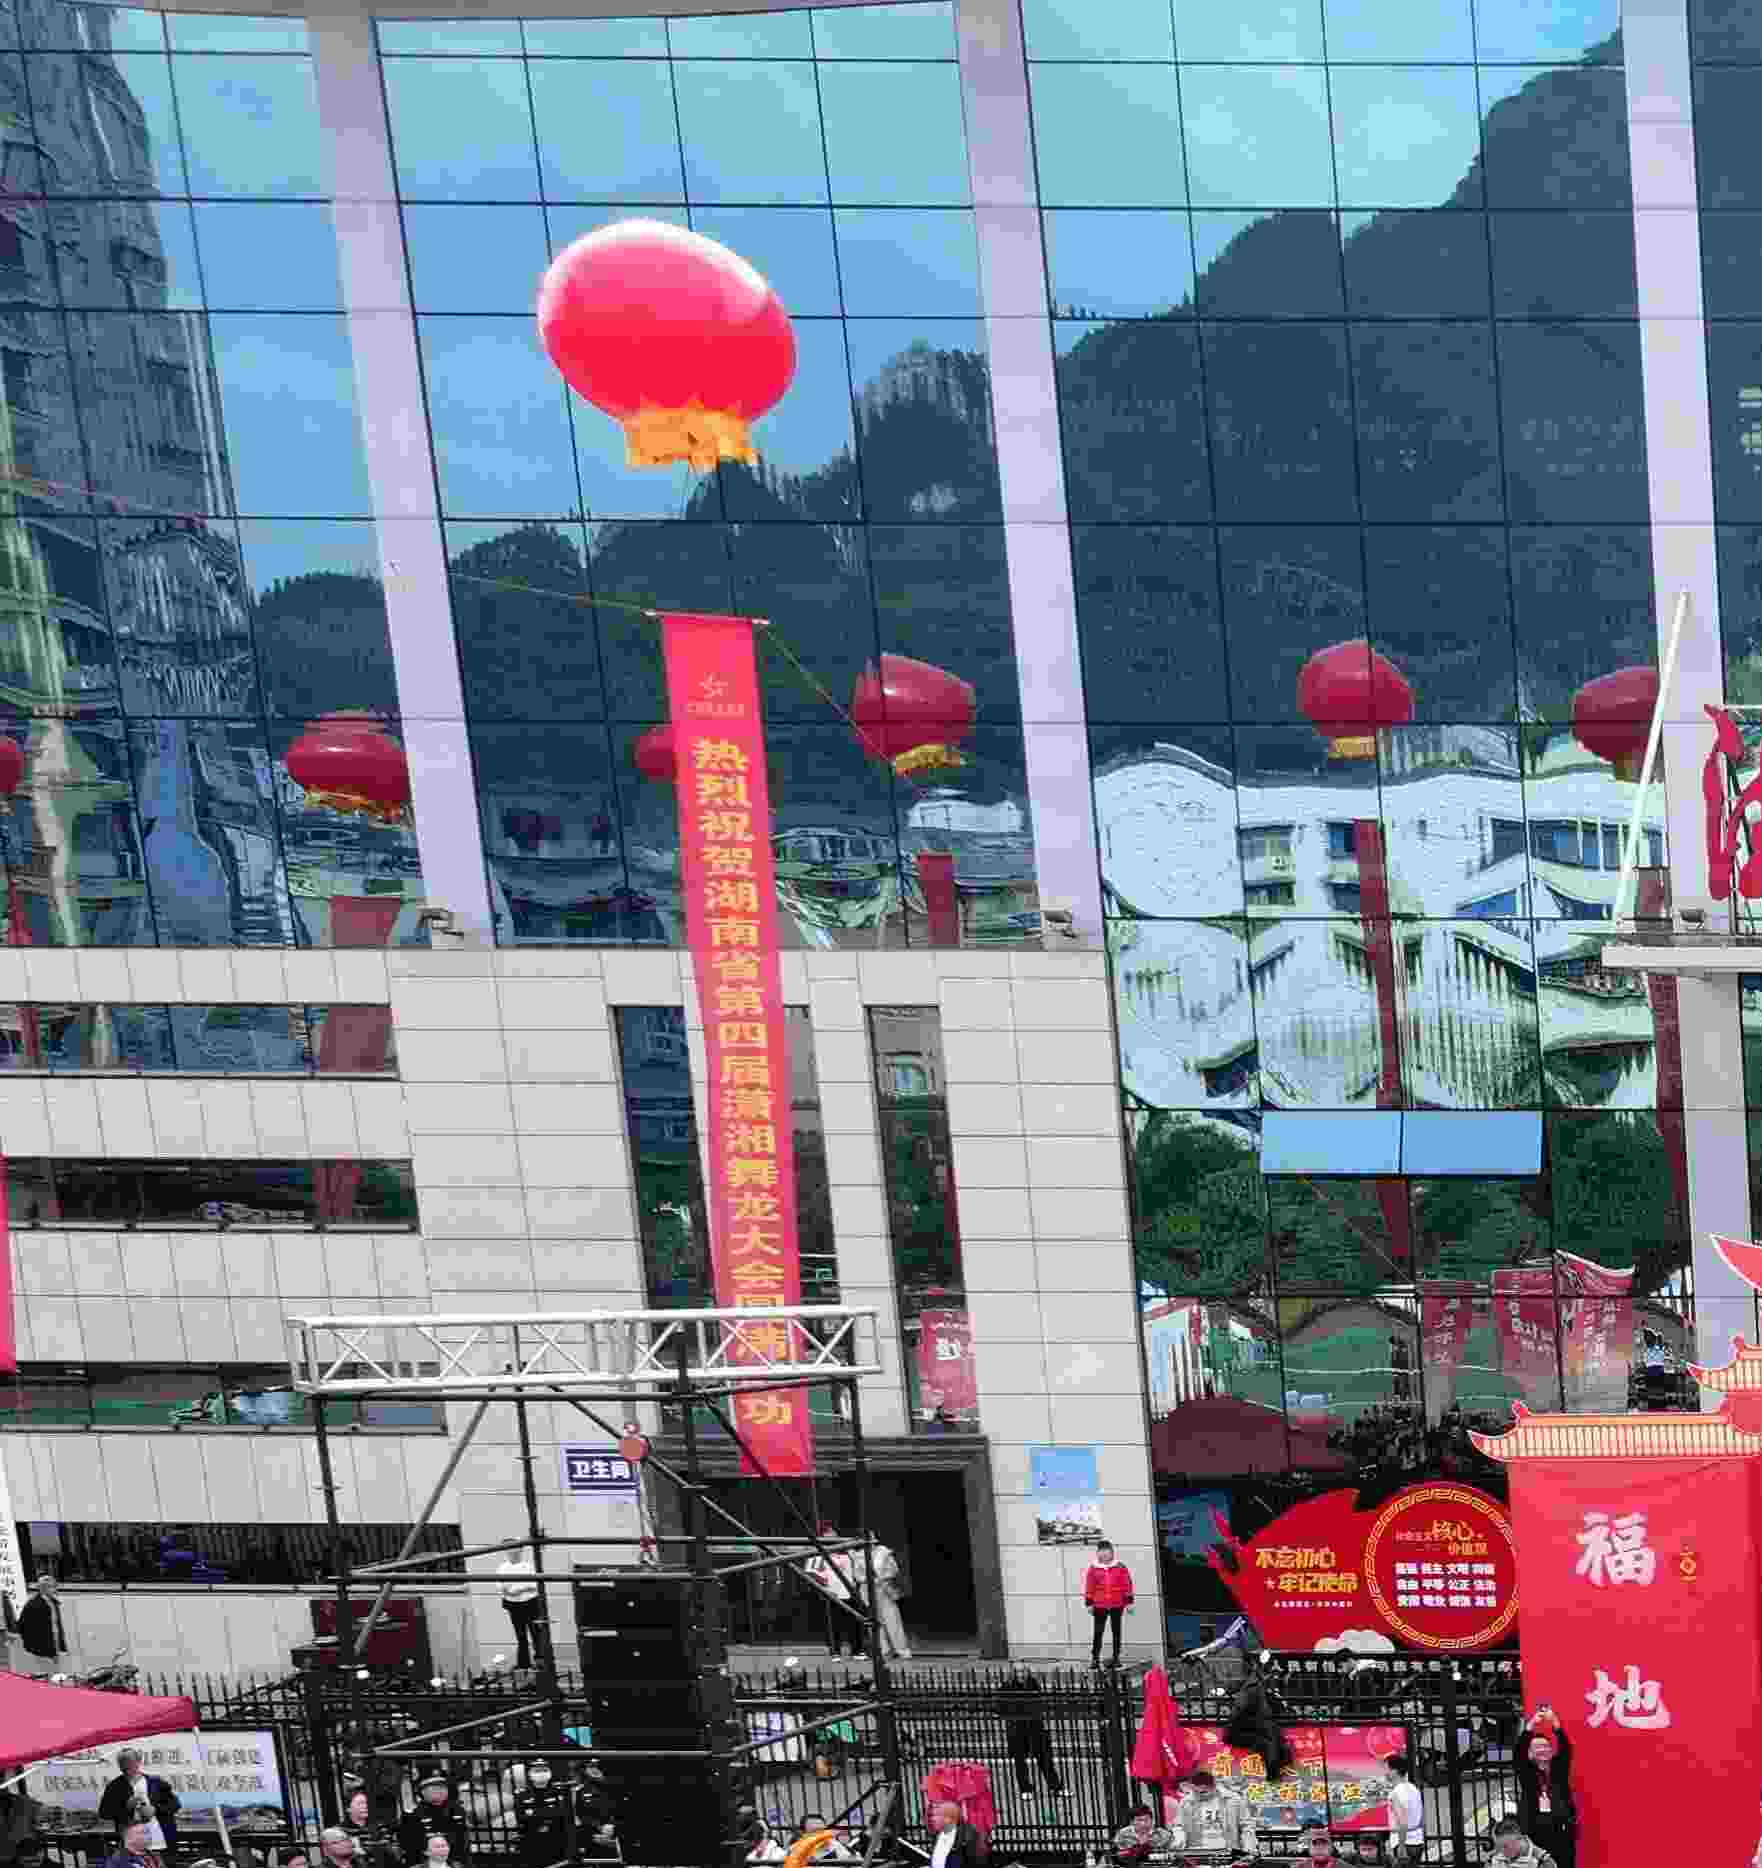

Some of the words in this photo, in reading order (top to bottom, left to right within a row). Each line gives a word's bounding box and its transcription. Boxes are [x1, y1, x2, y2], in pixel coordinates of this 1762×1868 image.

[572, 1460, 630, 1478] 卫生间
[1256, 1546, 1337, 1569] 不忘初心
[1575, 1510, 1673, 1731] 福地
